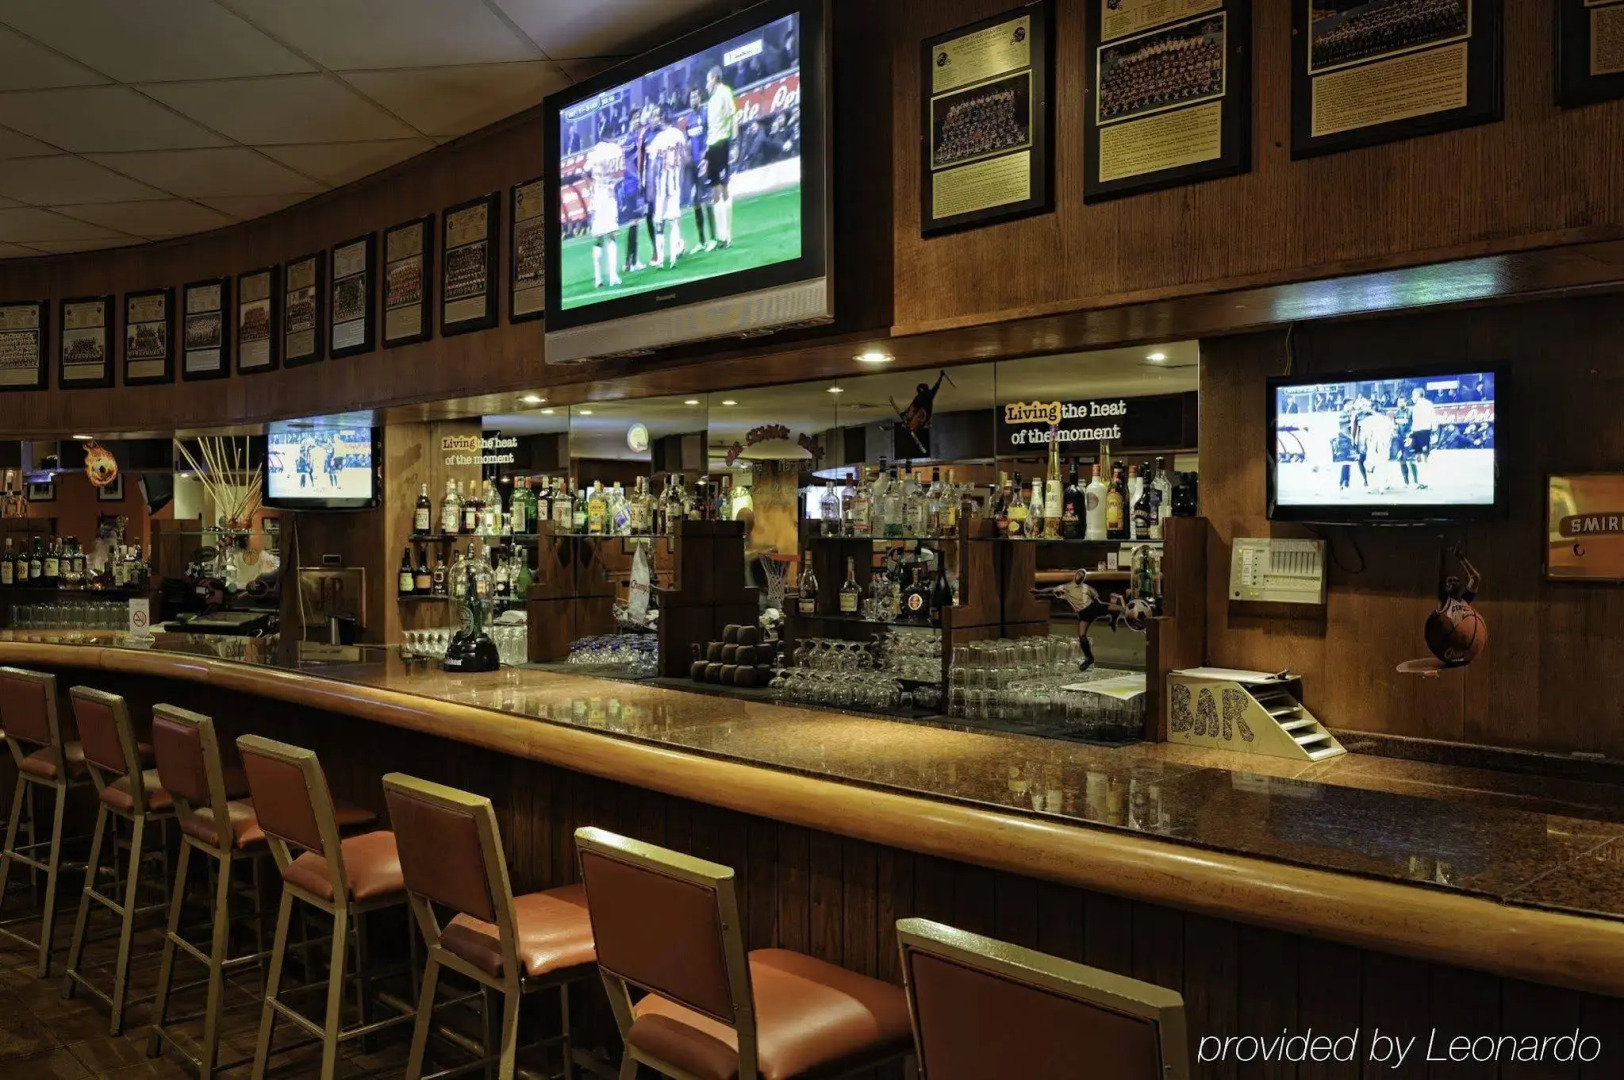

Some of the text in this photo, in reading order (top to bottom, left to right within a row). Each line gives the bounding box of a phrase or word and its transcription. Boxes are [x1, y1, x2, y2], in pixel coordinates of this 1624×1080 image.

[1007, 400, 1127, 422] Living the heat
[443, 436, 518, 450] Living the heat
[1011, 424, 1121, 445] of the moment
[445, 452, 515, 466] of the moment
[1571, 516, 1624, 533] SMIR
[1170, 683, 1255, 743] BAR
